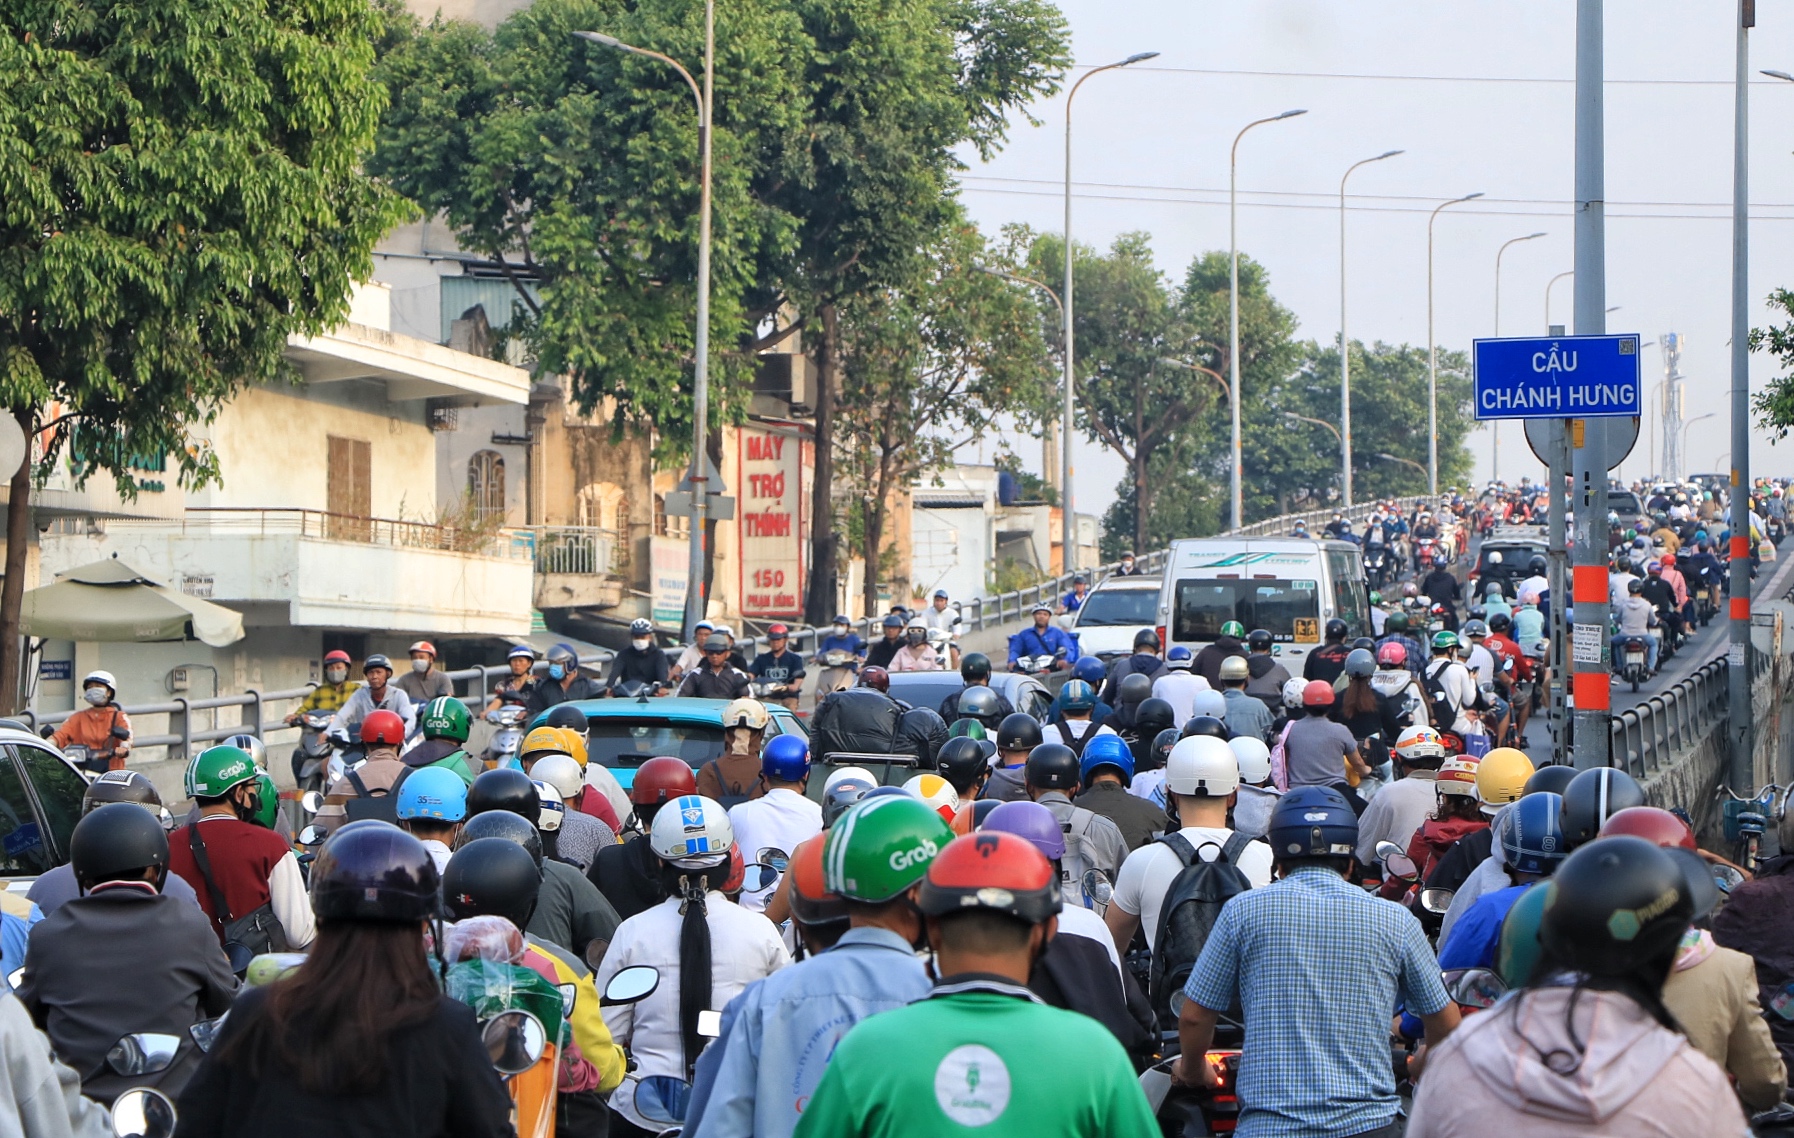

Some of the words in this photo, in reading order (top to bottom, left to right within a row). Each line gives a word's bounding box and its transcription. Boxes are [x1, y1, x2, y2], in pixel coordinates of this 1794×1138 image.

[1532, 342, 1578, 373] CẦU
[1482, 382, 1561, 409] CHÁNH
[1569, 383, 1635, 407] HƯNG
[747, 430, 785, 460] MÁY
[749, 469, 785, 505] TRỢ
[745, 506, 790, 537] THÍNH
[753, 569, 785, 588] 150
[426, 718, 450, 728] Grab
[218, 761, 246, 780] Grab
[417, 796, 427, 804] 35
[889, 839, 938, 871] Grab
